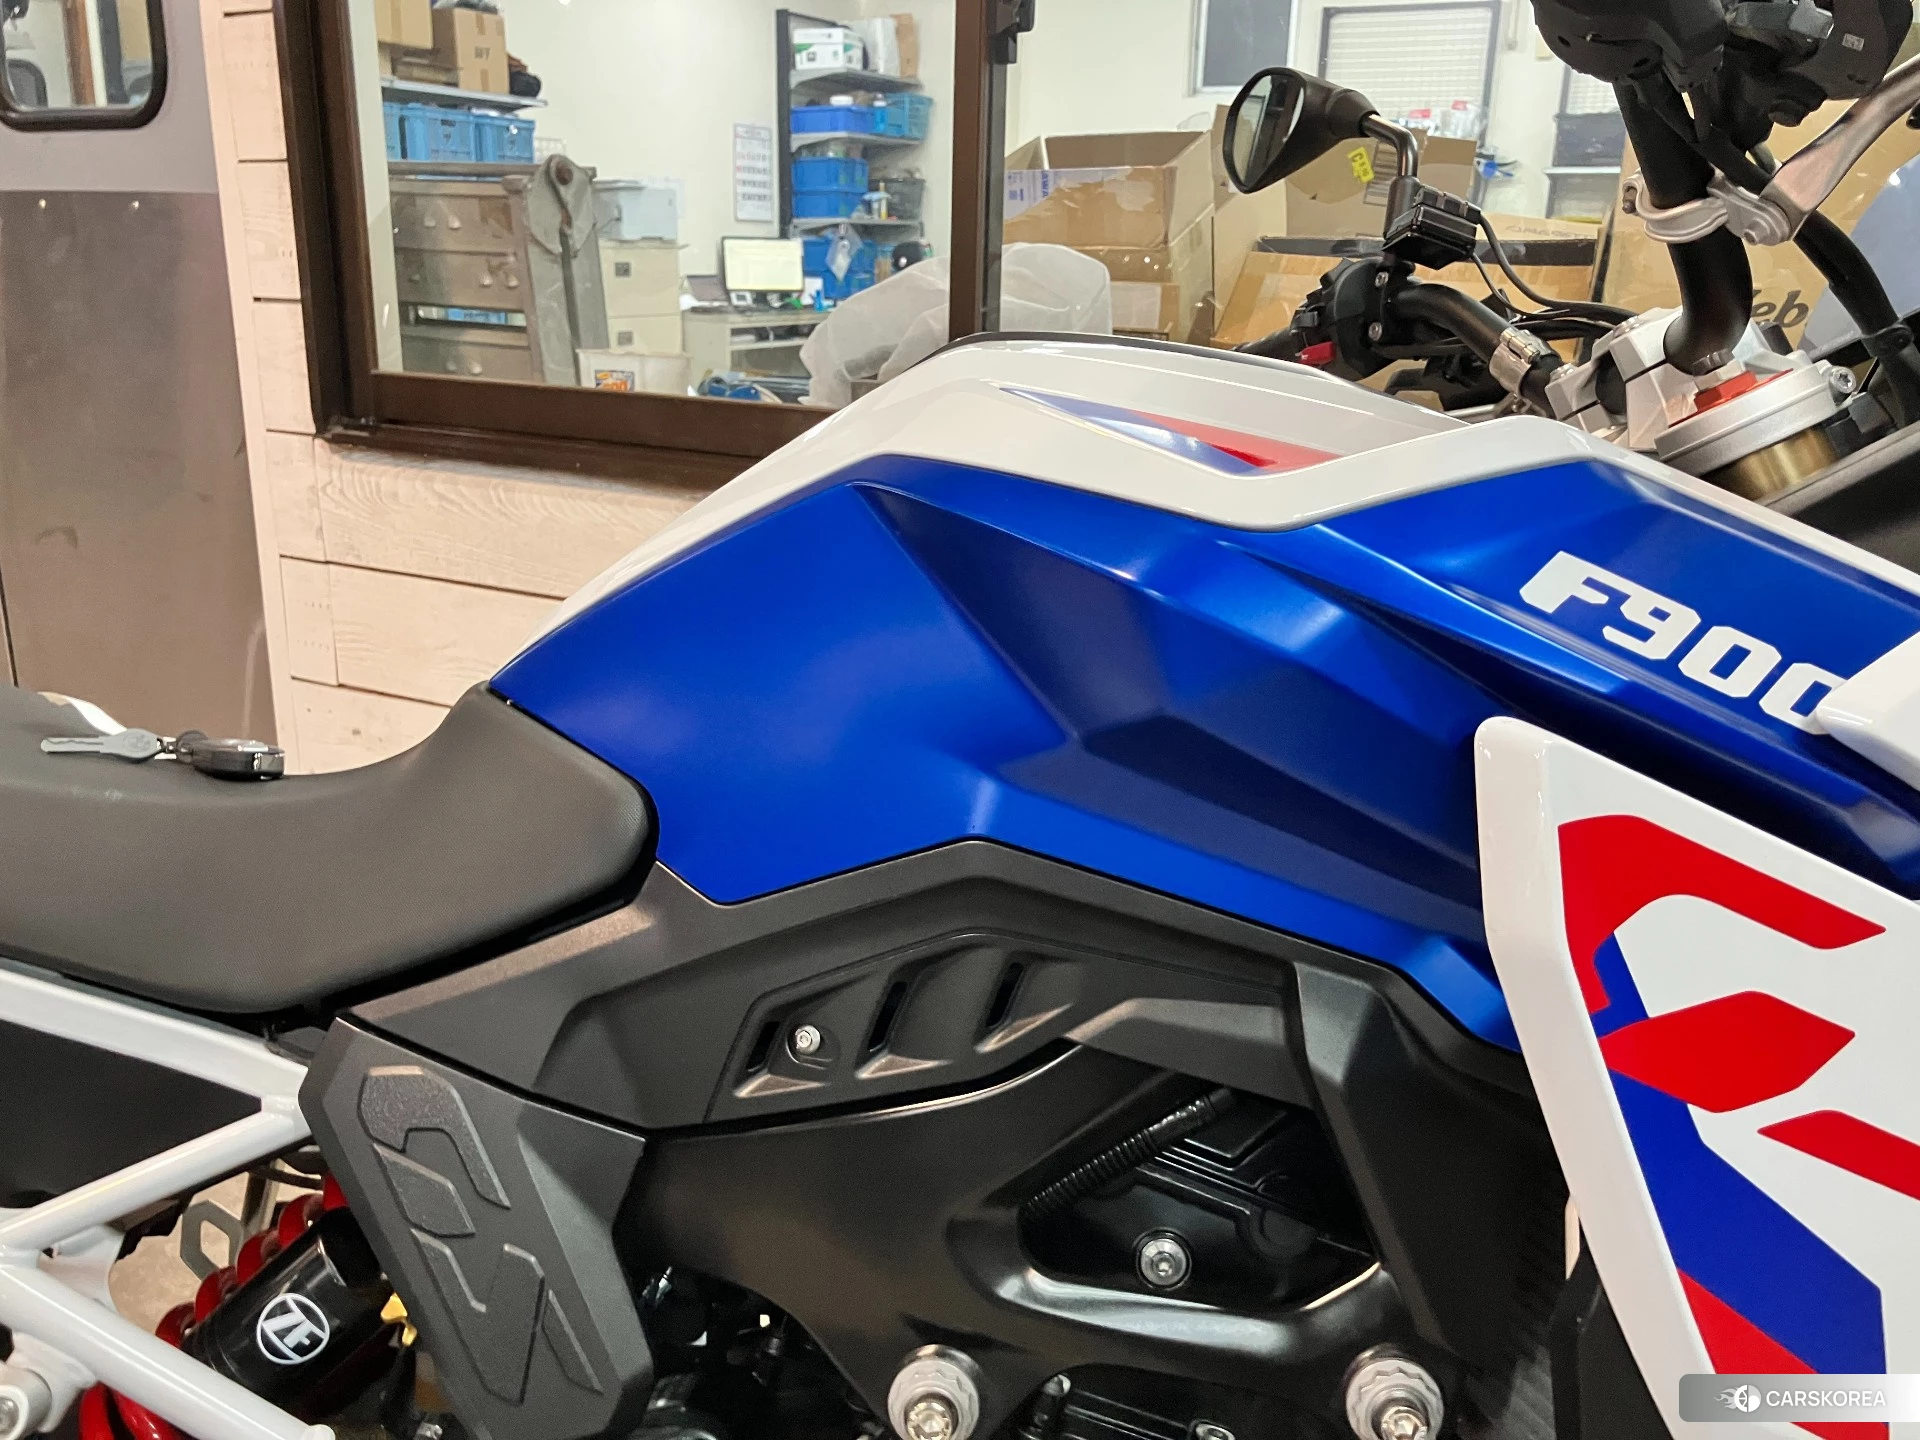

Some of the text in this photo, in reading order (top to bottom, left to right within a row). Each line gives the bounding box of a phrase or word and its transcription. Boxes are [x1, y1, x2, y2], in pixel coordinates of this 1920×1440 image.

[1752, 289, 1809, 328] eb
[1519, 550, 1849, 735] F900
[258, 1294, 329, 1363] ZF
